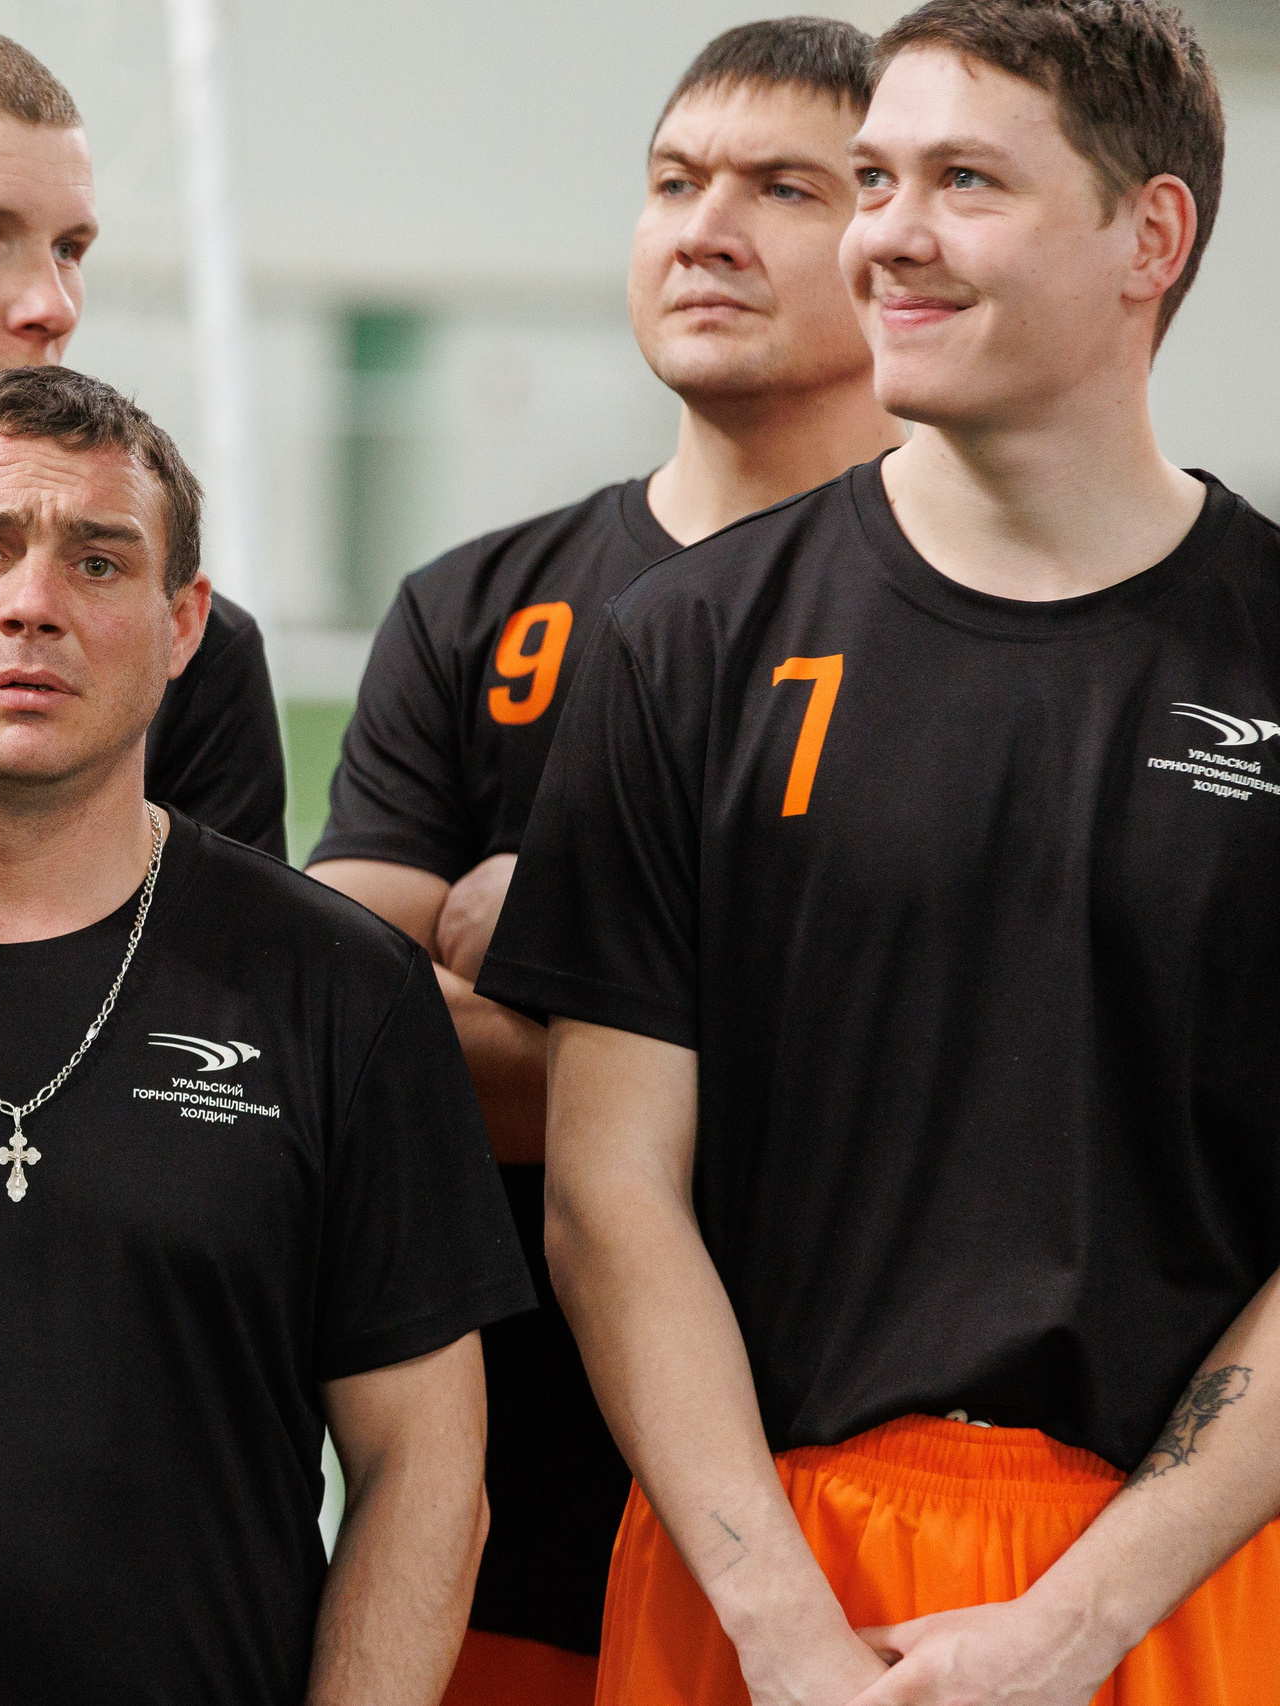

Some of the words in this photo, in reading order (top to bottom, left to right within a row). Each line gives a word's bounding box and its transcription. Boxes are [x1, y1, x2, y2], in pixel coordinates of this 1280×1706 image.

[488, 601, 574, 725] 9
[771, 653, 844, 817] 7
[1187, 748, 1262, 775] УРАЛЬСКИЙ
[1192, 779, 1253, 801] ХОЛДИНГ
[171, 1077, 244, 1098] УРАЛЬСКИЙ
[132, 1088, 281, 1119] ГОРНОПРОМЫШЛЕННЫЙ
[180, 1106, 238, 1125] ХОЛДИНГ
